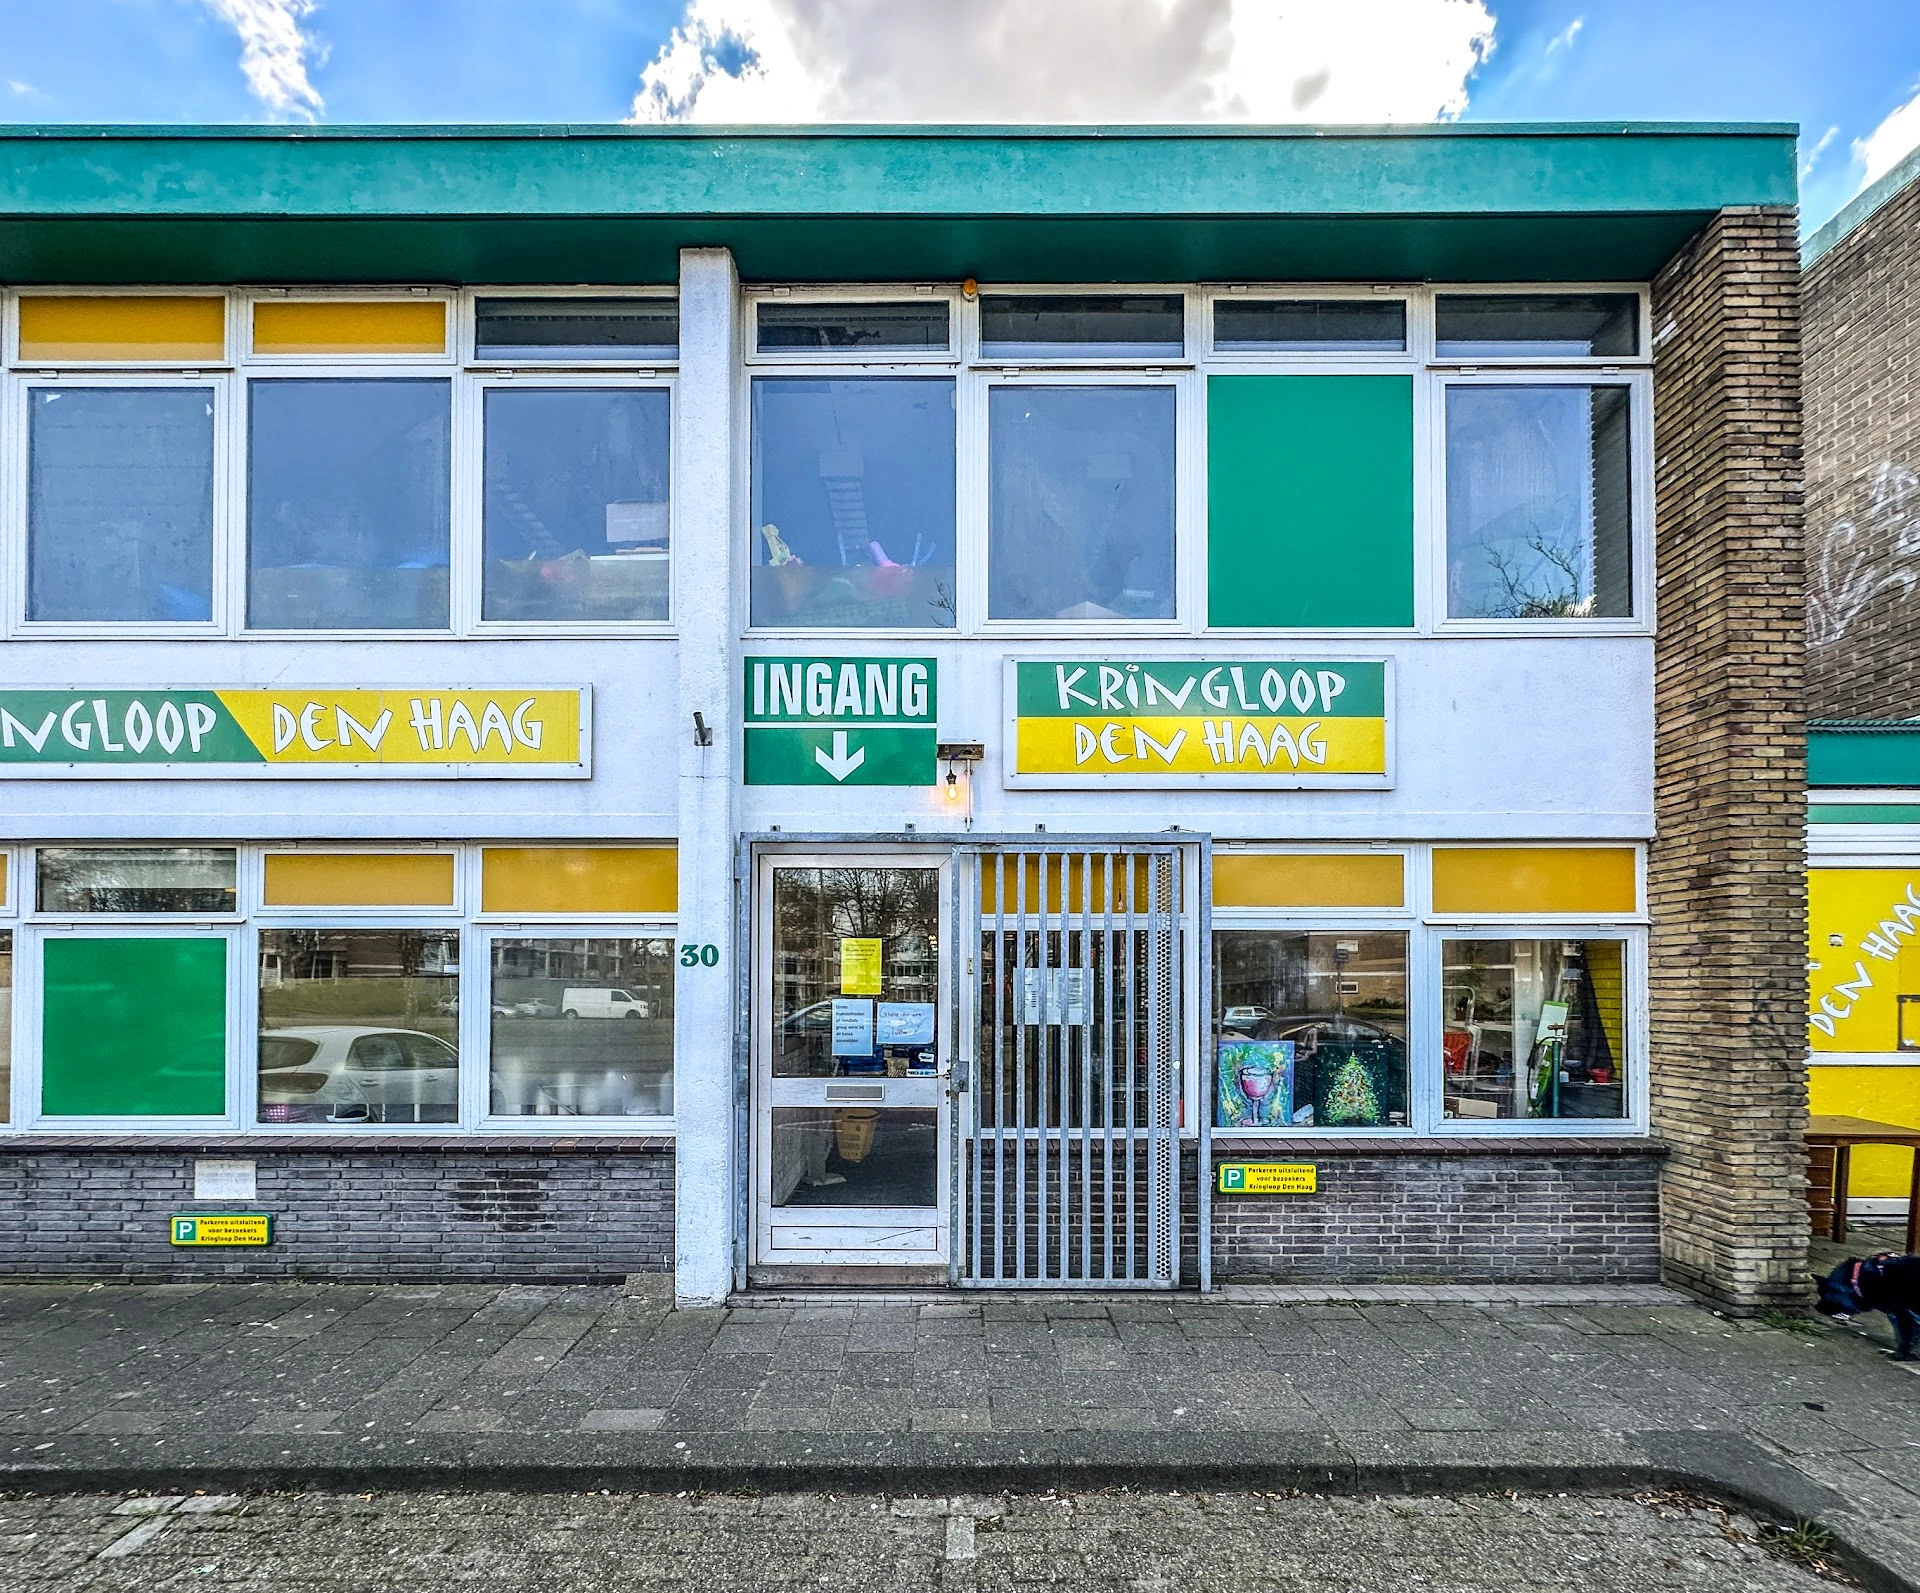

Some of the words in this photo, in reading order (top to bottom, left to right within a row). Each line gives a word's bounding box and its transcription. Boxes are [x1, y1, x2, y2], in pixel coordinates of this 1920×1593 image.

[754, 663, 928, 717] INGANG
[0, 699, 217, 755] NGLOOP
[272, 701, 393, 756] DEN
[409, 697, 544, 755] HAAG
[1075, 722, 1187, 766] DEN
[1203, 720, 1328, 768] HAAG
[680, 944, 719, 967] 30
[1809, 961, 1874, 1038] DEN
[1228, 1169, 1241, 1187] P
[179, 1221, 192, 1240] P
[230, 1218, 266, 1226] uitsluitend
[201, 1235, 232, 1243] Kringloop
[248, 1235, 265, 1243] Haag
